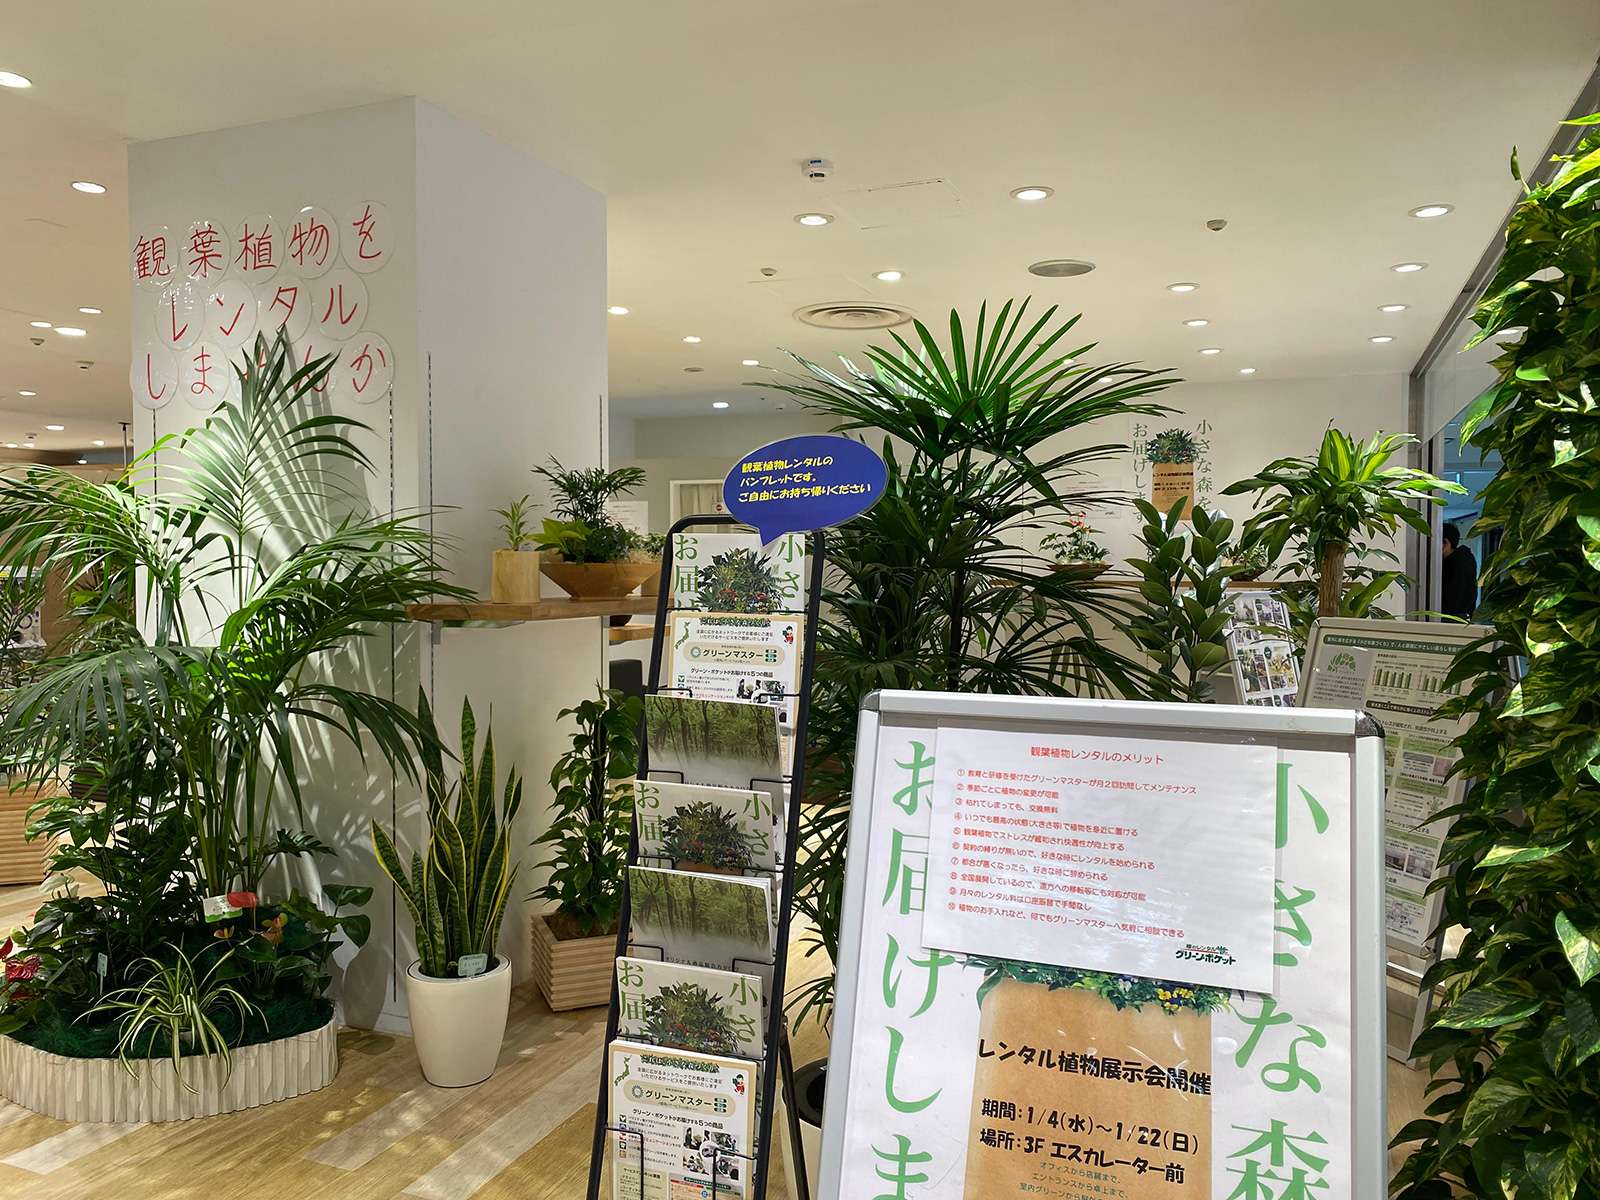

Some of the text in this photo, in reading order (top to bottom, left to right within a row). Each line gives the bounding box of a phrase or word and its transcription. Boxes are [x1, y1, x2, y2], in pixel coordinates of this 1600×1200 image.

[133, 205, 382, 279] 観葉植物を
[171, 285, 357, 341] レンタル
[741, 456, 834, 473] 観葉植物レンタルの
[740, 472, 816, 488] パンフレットです。
[738, 484, 871, 502] ご自由にお持ち帰りください
[778, 535, 803, 614] 小さ
[703, 649, 763, 659] グリーンマスター
[1030, 746, 1164, 765] 観葉植物レンタルのメリット
[967, 784, 1059, 799] 季節ごとに植物の変更が可能
[966, 800, 1058, 814] 枯れてしまっても、交換無料
[964, 828, 1125, 851] 観葉植物でストレスが緩和され快適性が向上する
[979, 1039, 1212, 1095] レンタル植物展示会開催
[645, 1090, 713, 1106] グリーンマスター
[980, 1128, 1185, 1184] 場所:3F エスカレーター前
[1040, 1162, 1121, 1184] オフィスから店舗まで、
[1033, 1173, 1128, 1198] エントランスから卓上まで、
